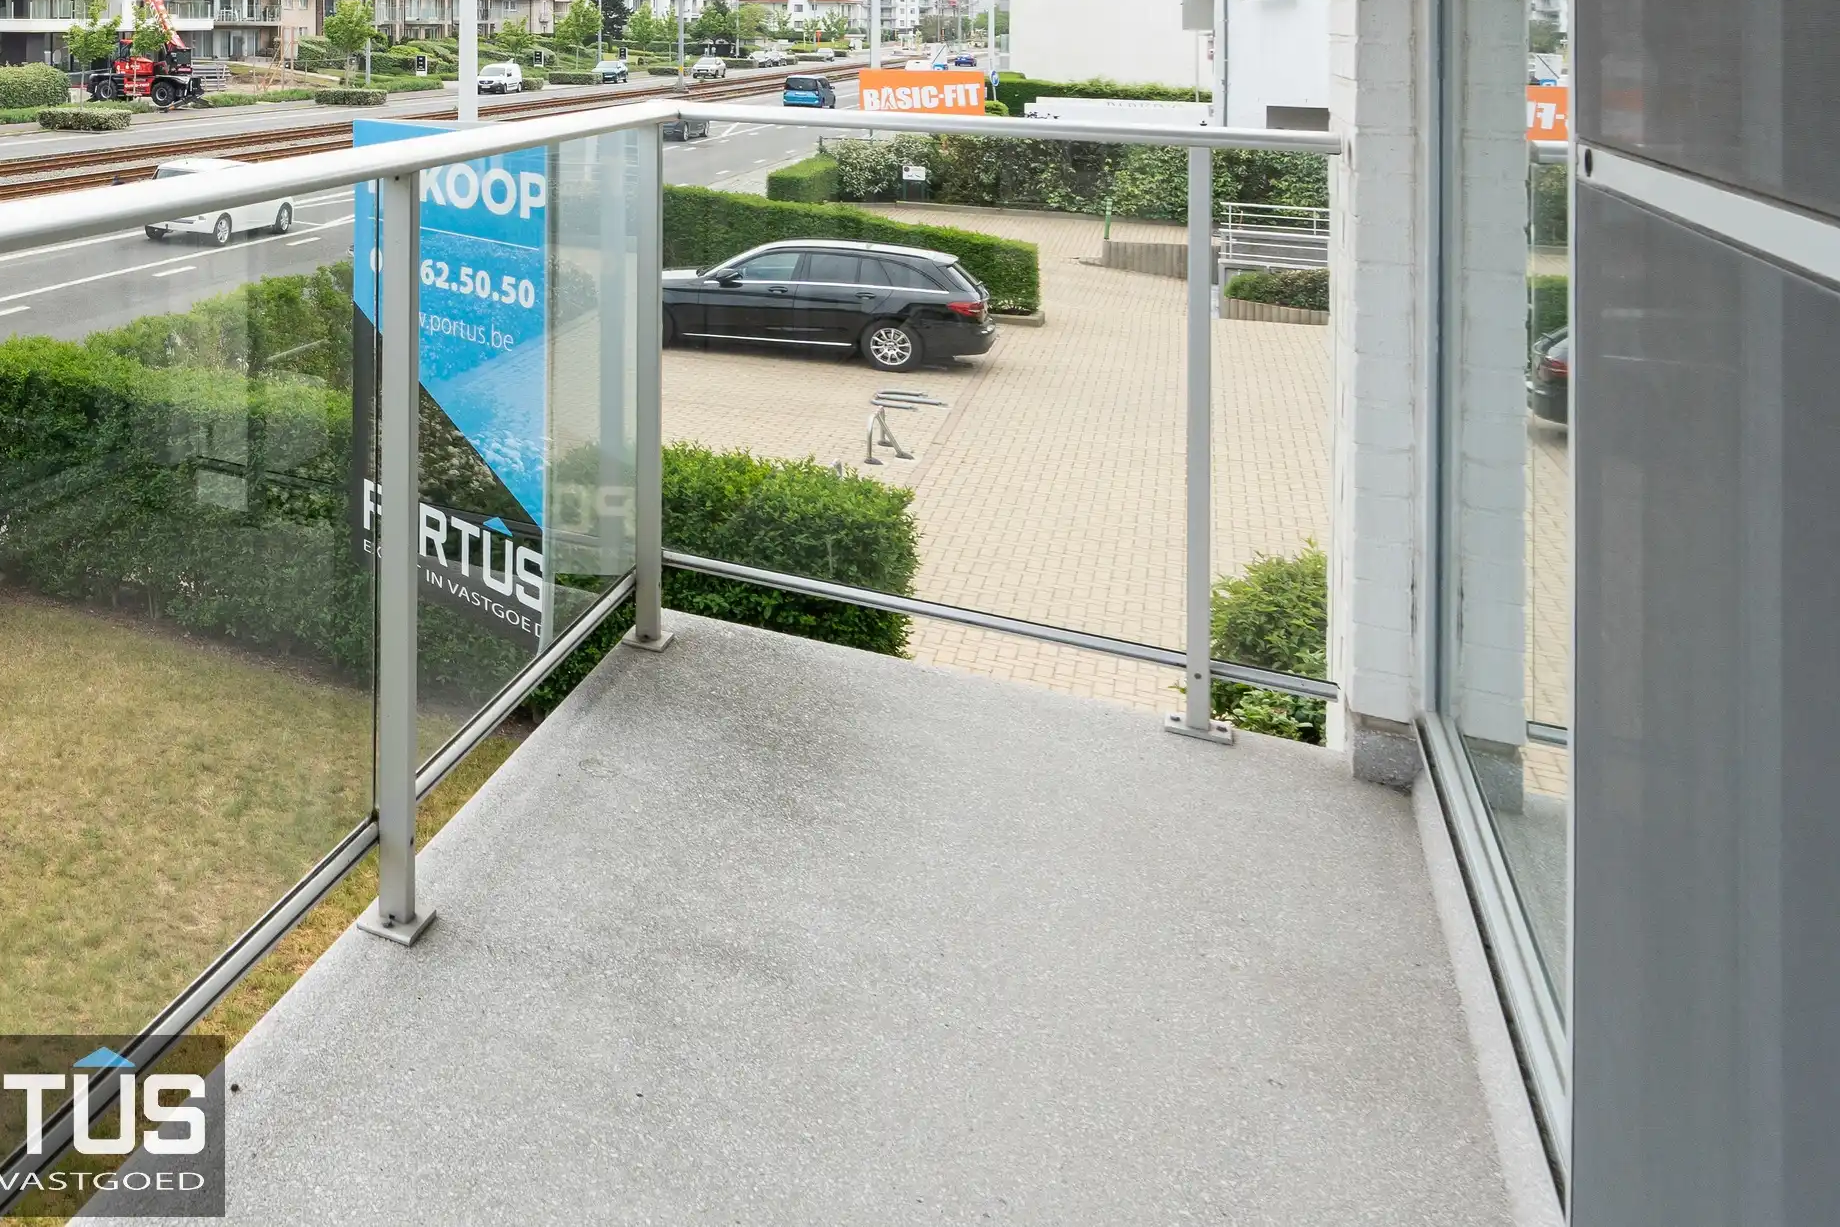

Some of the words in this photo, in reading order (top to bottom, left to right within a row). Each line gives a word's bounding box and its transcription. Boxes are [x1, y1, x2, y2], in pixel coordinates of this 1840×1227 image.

[863, 83, 981, 111] BASIC-FIT
[420, 163, 546, 219] KOOP
[363, 478, 543, 611] PRTUS
[426, 569, 443, 589] IN
